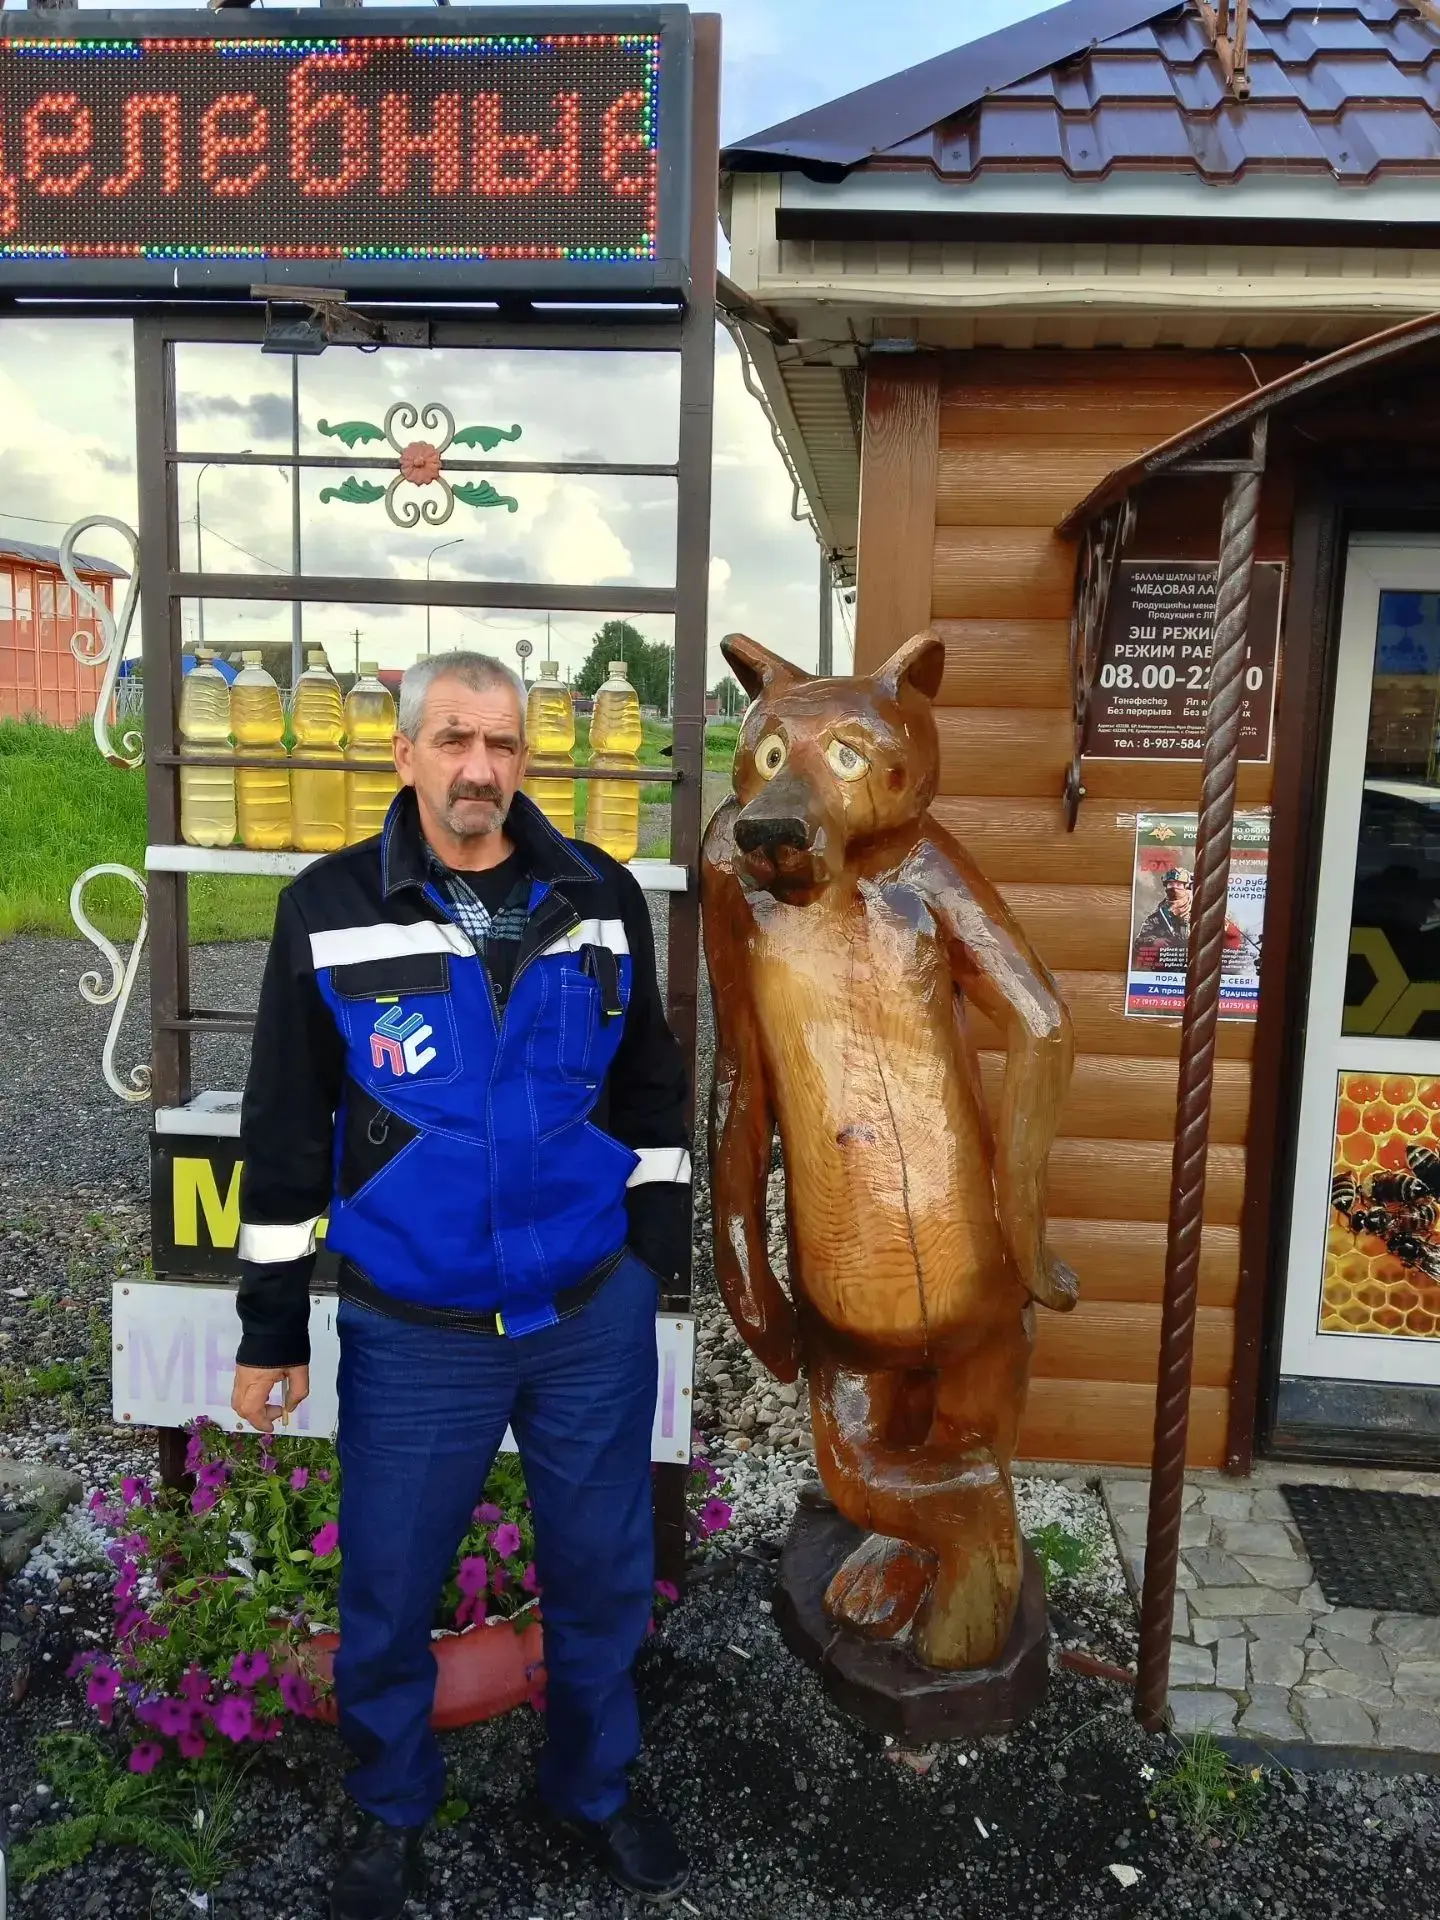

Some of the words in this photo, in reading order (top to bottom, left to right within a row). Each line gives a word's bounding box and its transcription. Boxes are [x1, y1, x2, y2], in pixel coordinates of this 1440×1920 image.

[0, 52, 656, 236] елебные
[1130, 583, 1195, 596] «МЕДОВАЯ
[1148, 610, 1195, 620] Продукция
[1129, 626, 1156, 639] ЭШ
[1162, 626, 1214, 640] РЕЖИ
[519, 644, 530, 653] 40
[1114, 644, 1175, 658] РЕЖИМ
[1107, 706, 1124, 715] Без
[1126, 708, 1172, 717] перерыва
[1183, 707, 1200, 716] Без
[1113, 739, 1134, 748] тел
[1143, 738, 1205, 749] 8-987-584-
